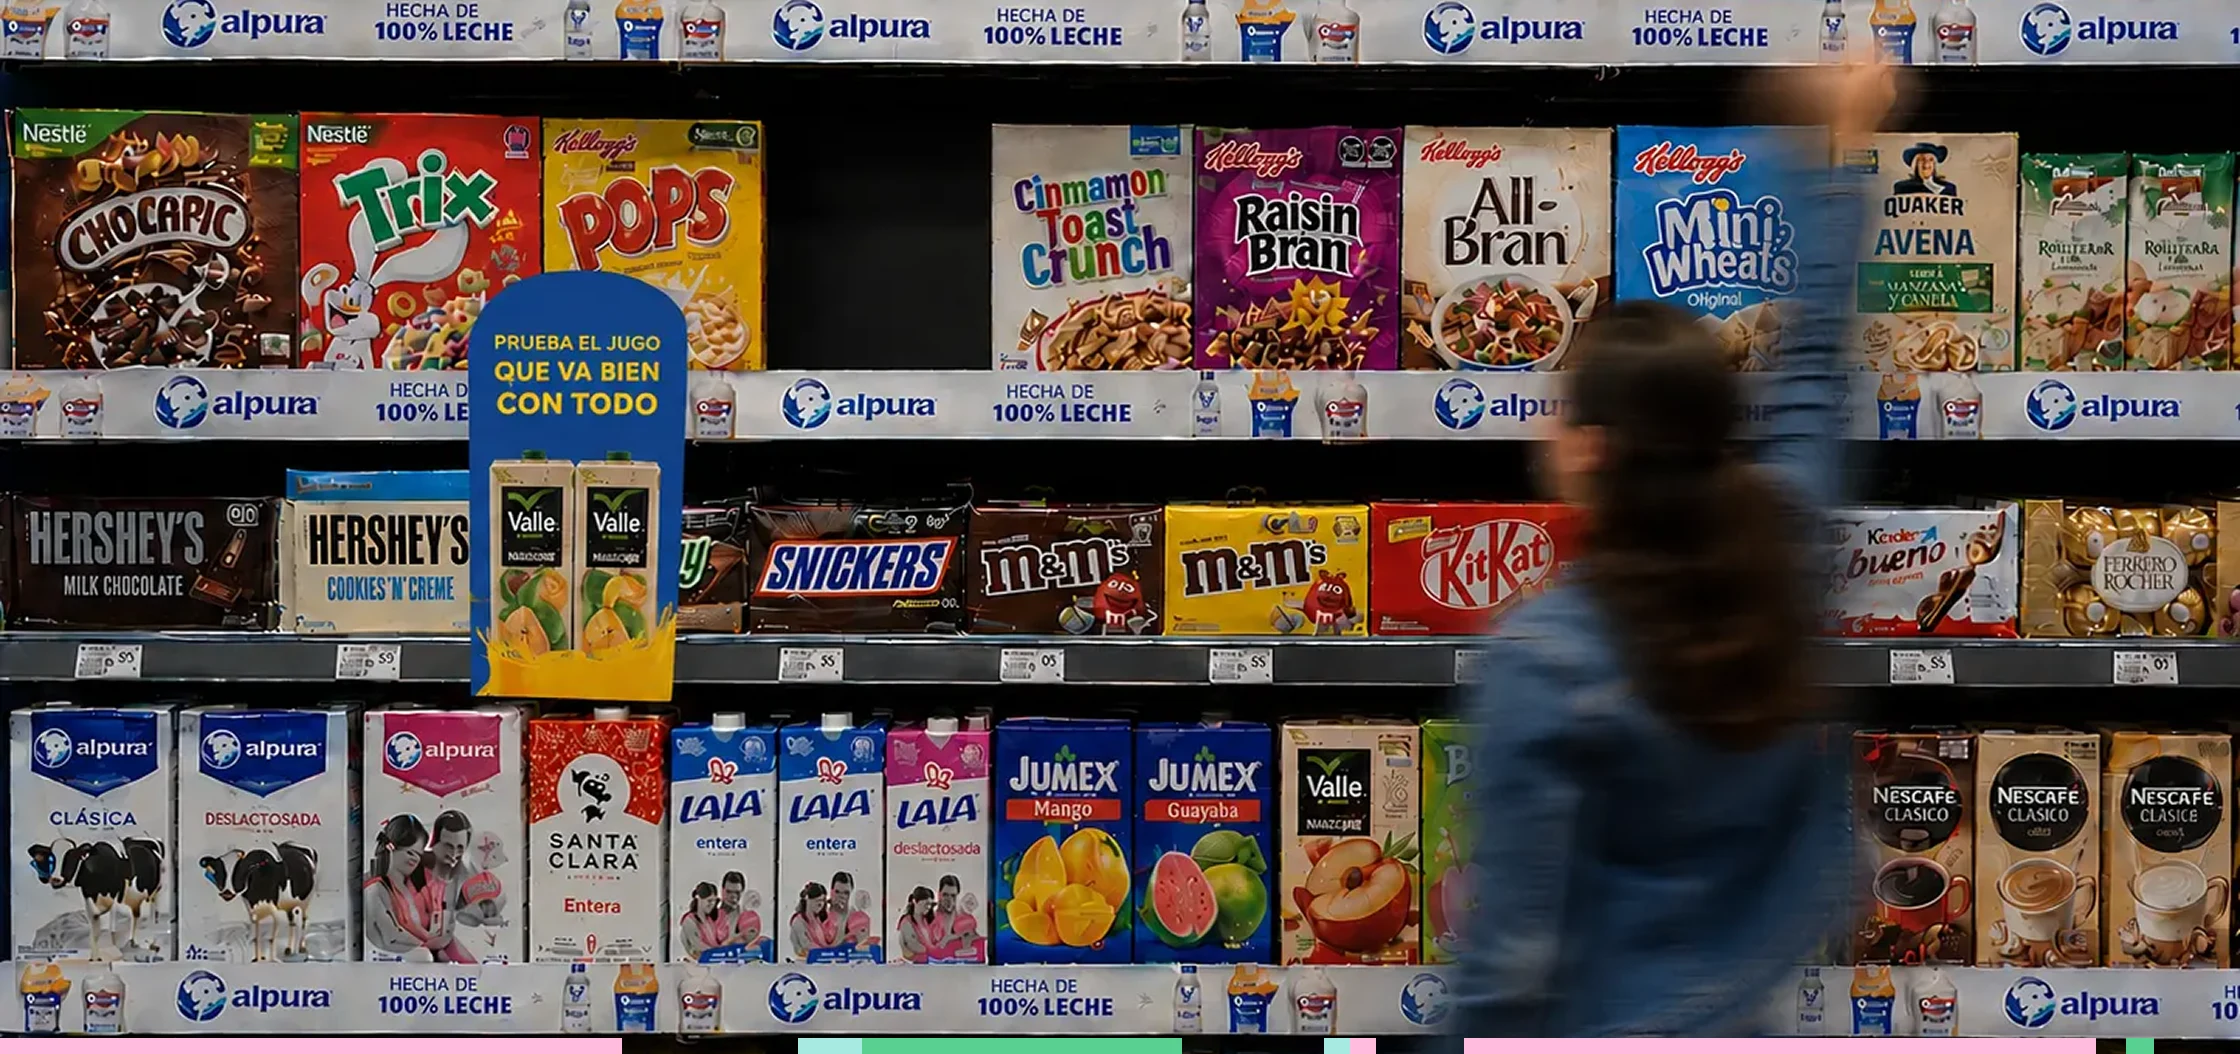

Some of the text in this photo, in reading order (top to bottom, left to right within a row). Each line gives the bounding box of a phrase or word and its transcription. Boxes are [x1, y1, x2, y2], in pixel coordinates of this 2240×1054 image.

[387, 3, 479, 18] HECHA DE
[998, 8, 1085, 23] HECHA DE
[1645, 10, 1732, 24] HECHA DE
[221, 10, 324, 40] alpura
[376, 22, 513, 42] 100% LECHE
[829, 13, 930, 43] alpura
[984, 26, 1122, 46] 100% LECHE
[1481, 16, 1583, 46] alpura
[1632, 27, 1768, 46] 100% LECHE
[2077, 16, 2178, 46] alpura
[554, 130, 638, 159] Kellogg's
[1421, 139, 1502, 168] Kellogg's
[1205, 142, 1303, 176] Kellogg's
[1634, 141, 1747, 184] Kellogg's
[334, 150, 498, 249] Trix
[1014, 168, 1167, 211] Cinnamon
[560, 165, 735, 271] POPS
[1235, 192, 1359, 240] Raisin
[1884, 196, 1964, 218] QUAKER
[1037, 198, 1138, 250] Toast
[1662, 197, 1775, 249] Mini
[1247, 233, 1352, 275] Bran
[1444, 217, 1567, 266] Bran
[1874, 229, 1975, 256] AVENA
[1022, 225, 1172, 287] Crunch
[1652, 248, 1792, 290] Wheats
[494, 335, 661, 351] PRUEBA EL JUGO
[494, 362, 660, 387] QUE VA BIEN
[390, 383, 449, 397] HECHA
[1007, 385, 1094, 400] HECHA DE
[213, 390, 318, 419] alpura
[376, 403, 439, 421] 100%
[496, 392, 658, 416] CON TODO
[837, 391, 936, 421] alpura
[993, 403, 1132, 423] 100% LECHE
[1490, 393, 1573, 421] alpur
[2082, 390, 2180, 421] alpura
[30, 511, 205, 565] HERSHEY'S
[309, 515, 469, 565] HERSHEY'S
[766, 542, 948, 590] SNICKERS
[1440, 521, 1549, 607] KitKat
[64, 575, 183, 597] MILK CHOCOLATE
[328, 576, 386, 602] COOKIES
[409, 576, 455, 601] CREME
[2104, 573, 2174, 592] ROCHER
[77, 739, 147, 759] alpura
[245, 740, 317, 759] alpura
[424, 741, 495, 761] alpura
[1009, 756, 1118, 793] JUMEX
[1148, 758, 1257, 793] JUMEX
[1444, 744, 1473, 786] B
[50, 808, 138, 826] CLÁSICA
[205, 812, 322, 827] DESLACTOSADA
[680, 789, 762, 824] LALA
[789, 789, 871, 824] LALA
[897, 794, 976, 829] LALA
[1033, 801, 1092, 821] Mango
[1167, 802, 1238, 824] Guayaba
[549, 833, 636, 850] SANTA
[696, 837, 748, 850] entera
[806, 837, 857, 850] entera
[893, 842, 981, 855] deslactosada
[548, 852, 638, 870] CLARA
[564, 898, 622, 913] Entera
[390, 977, 478, 992] HECHA DE
[990, 979, 1077, 993] HECHA DE
[232, 986, 330, 1013] alpura
[378, 995, 512, 1015] 100% LECHE
[823, 987, 922, 1015] alpura
[977, 998, 1114, 1017] 100% LECHE
[2061, 991, 2160, 1020] alpura
